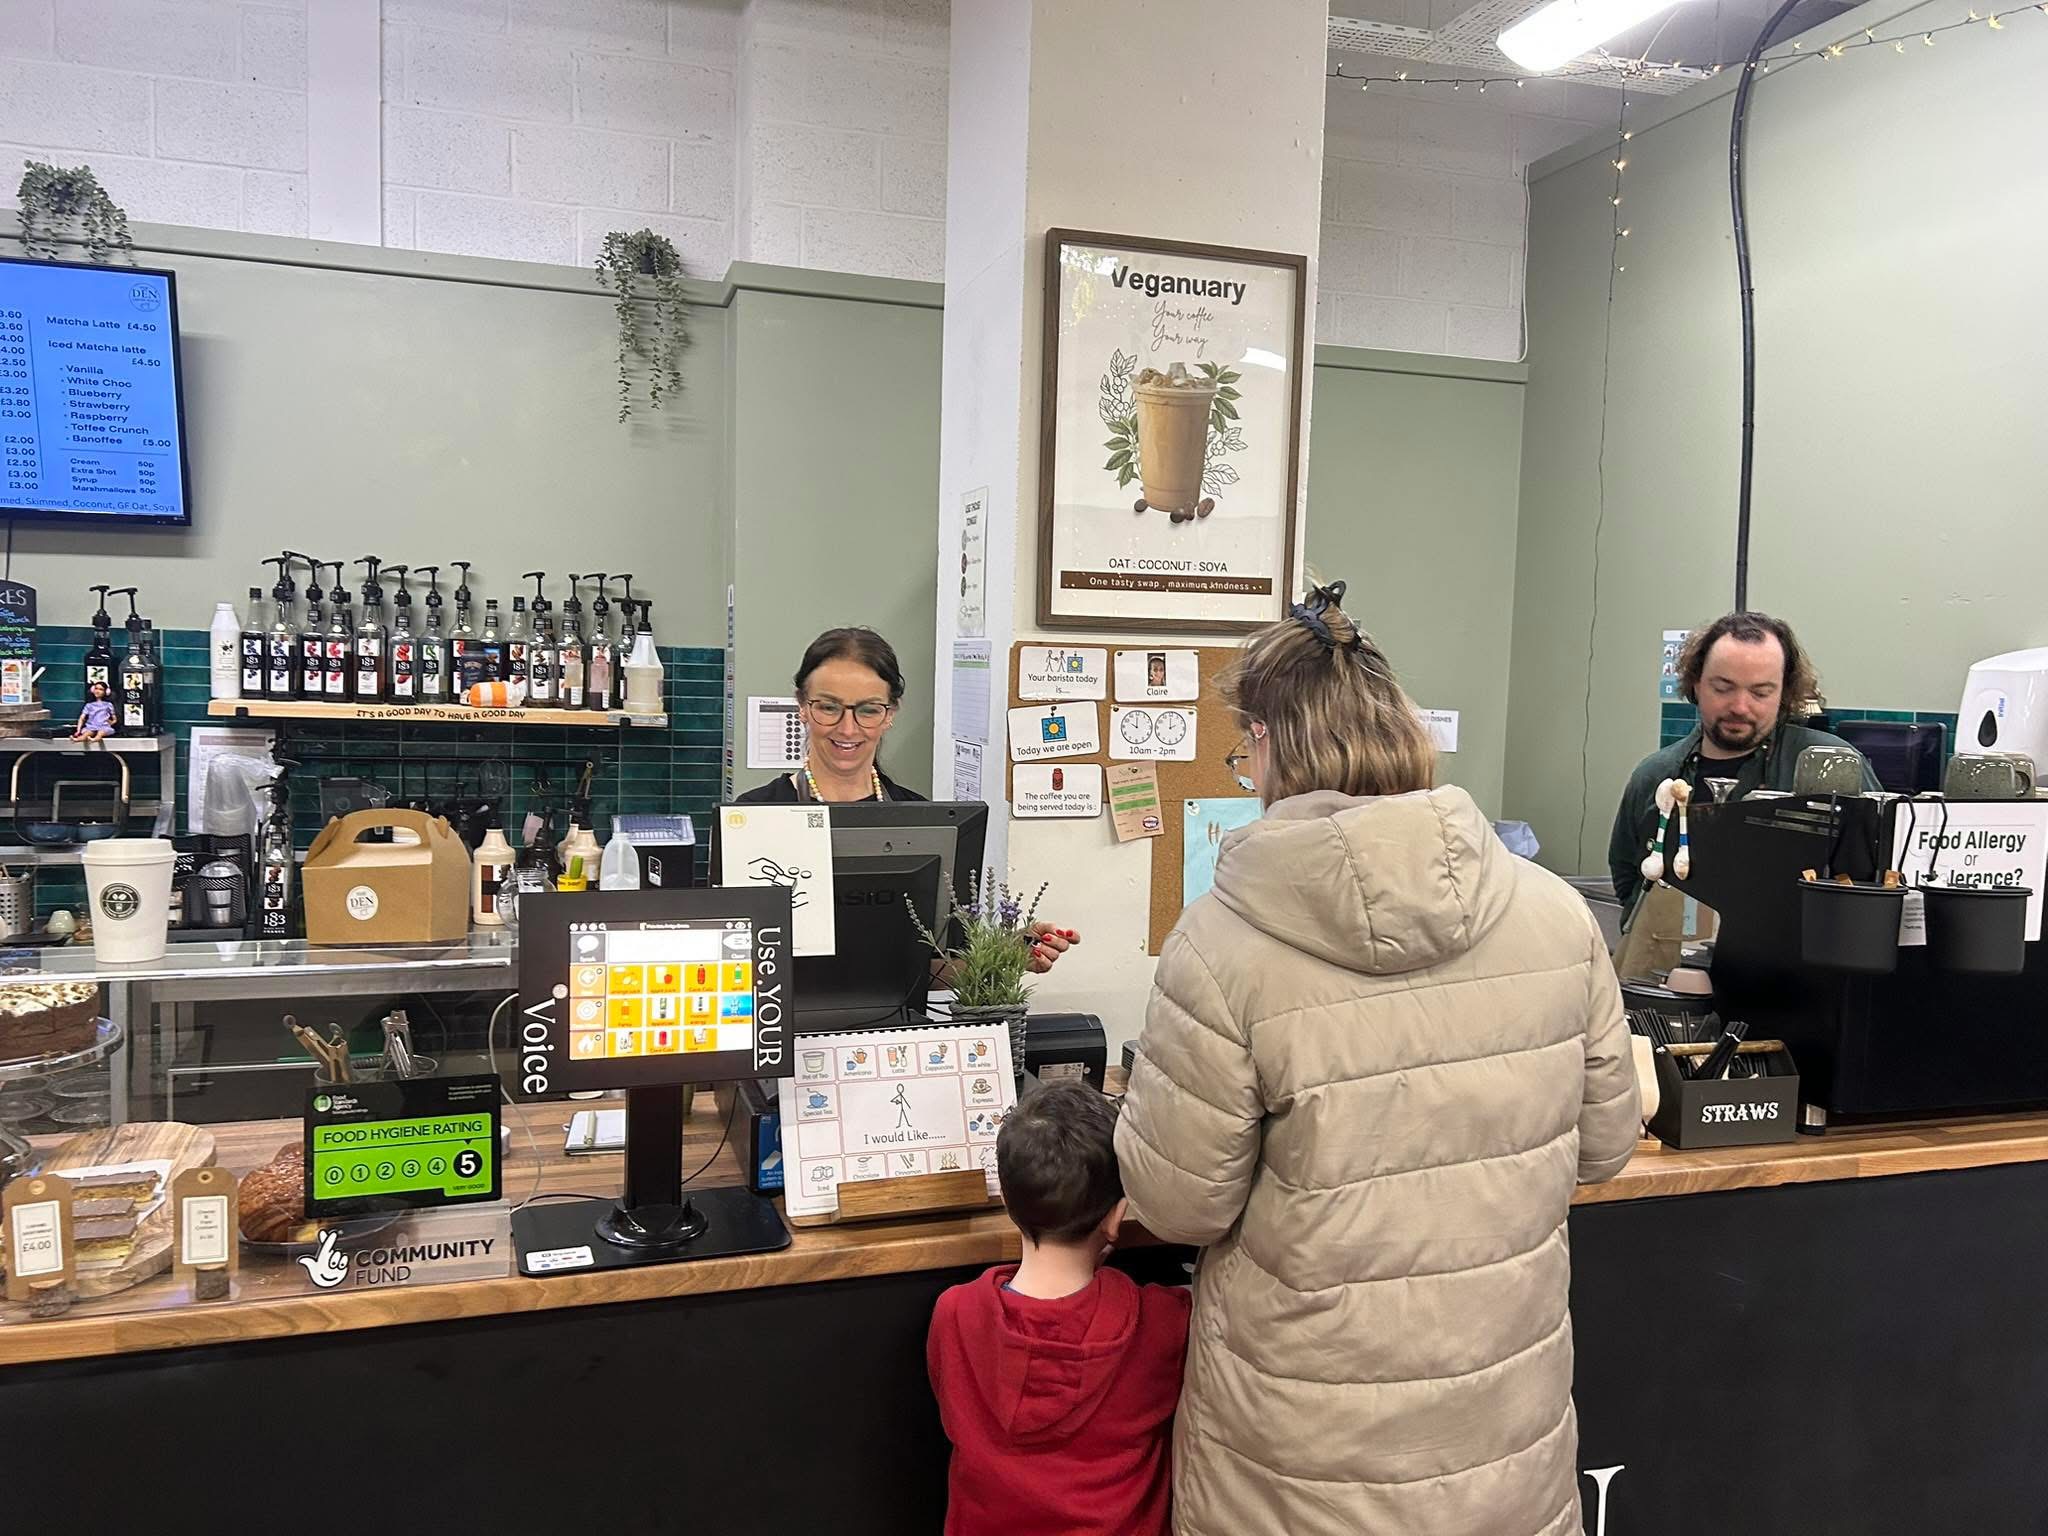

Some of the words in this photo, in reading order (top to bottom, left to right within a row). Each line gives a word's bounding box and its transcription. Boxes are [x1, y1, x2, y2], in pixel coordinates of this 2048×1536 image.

[1111, 265, 1247, 306] Veganuary
[1151, 300, 1184, 327] Your
[1187, 306, 1214, 331] coffee
[46, 315, 89, 327] Matcha
[92, 319, 121, 329] Latte
[127, 322, 157, 332] £4.50
[48, 340, 73, 349] Iced
[76, 341, 118, 353] Matcha
[121, 345, 147, 354] latte
[1151, 324, 1183, 352] Your
[1186, 337, 1208, 359] way
[132, 357, 161, 367] £4.50
[65, 364, 104, 375] Vanilla
[67, 376, 99, 386] White
[102, 378, 133, 388] Choc
[68, 388, 122, 400] Blueberry
[69, 400, 130, 412] Strawberry
[1, 410, 32, 419] £3.00
[70, 411, 128, 423] Raspberry
[70, 423, 106, 433] Toffee
[108, 425, 149, 435] Crunch
[4, 435, 34, 445] £2.00
[72, 434, 123, 444] Banoffee
[143, 438, 171, 447] £5.00
[6, 447, 35, 456] £3.00
[7, 459, 37, 468] £2.50
[70, 458, 100, 466] Cream
[8, 470, 38, 479] £3.00
[71, 467, 94, 475] Extra
[96, 468, 117, 476] Shot
[138, 469, 155, 477] 50p
[9, 481, 39, 490] £3.00
[71, 475, 98, 484] Syrup
[139, 478, 156, 487] 50p
[72, 484, 137, 495] Marshmallows
[140, 487, 157, 495] 50p
[73, 499, 115, 510] Coconut,
[1108, 558, 1131, 569] OAT
[1138, 559, 1192, 571] COCONUT
[1199, 562, 1228, 573] SOYA
[1090, 576, 1108, 586] One
[1111, 577, 1134, 588] tasty
[1168, 579, 1207, 589] maximum
[1209, 581, 1249, 591] kindness
[1028, 673, 1046, 682] Your
[1047, 673, 1074, 683] barista
[1075, 674, 1098, 685] today
[1146, 687, 1169, 696] Claire
[356, 709, 375, 719] IT'S
[386, 707, 412, 717] GOOD
[414, 707, 432, 716] DAY
[433, 709, 446, 718] TO
[447, 711, 471, 720] HAVE
[473, 711, 480, 719] A
[481, 709, 507, 718] GOOD
[508, 711, 526, 720] DAY
[1017, 746, 1041, 756] Today
[1043, 744, 1055, 753] we
[1056, 743, 1070, 751] are
[1072, 740, 1092, 751] open
[1129, 746, 1152, 755] 10am
[1159, 746, 1176, 757] 2pm
[1024, 792, 1039, 800] The
[1040, 791, 1062, 801] coffee
[1063, 793, 1077, 802] you
[1017, 802, 1038, 813] being
[1040, 802, 1063, 811] served
[1064, 802, 1085, 813] today
[1918, 831, 1962, 850] Food
[1965, 831, 2027, 853] Allergy
[1963, 854, 1979, 866] or
[757, 926, 781, 975] Use
[758, 984, 783, 1067] YOUR
[523, 998, 556, 1094] Voice
[1701, 1102, 1779, 1123] STRAWS
[323, 1129, 368, 1144] FOOD
[370, 1124, 430, 1140] HYGIENE
[433, 1120, 483, 1135] RATING
[864, 1134, 869, 1145] I
[871, 1132, 905, 1144] would
[460, 1153, 476, 1175] 5
[23, 1240, 52, 1252] £4.00
[354, 1238, 495, 1268] COMMUNITY
[356, 1265, 411, 1286] FUND
